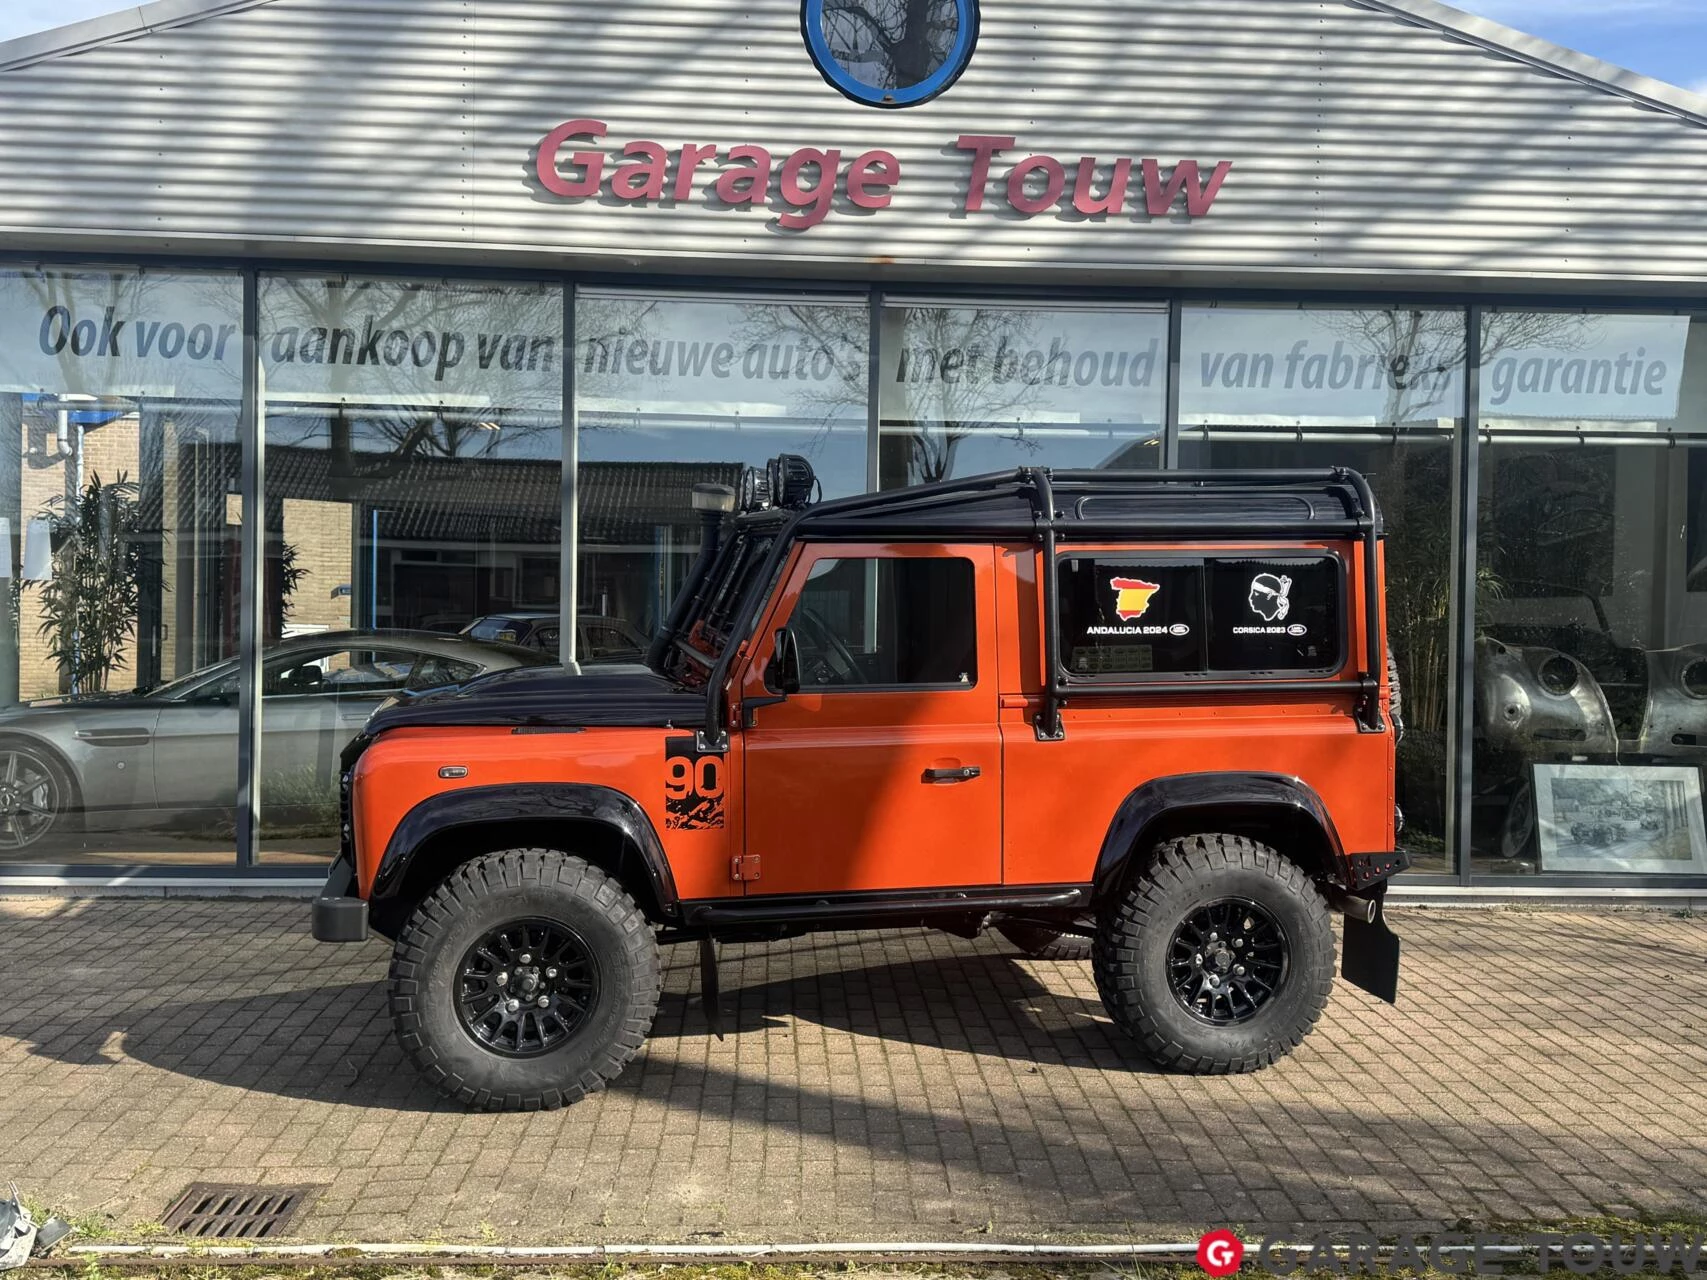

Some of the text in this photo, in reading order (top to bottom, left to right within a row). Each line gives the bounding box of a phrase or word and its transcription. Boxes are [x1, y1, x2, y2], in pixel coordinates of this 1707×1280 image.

[536, 119, 1233, 230] Garage Touw
[39, 306, 125, 358] Ook
[135, 322, 236, 361] voor
[272, 315, 465, 381] aankoop
[477, 332, 553, 373] van
[583, 327, 732, 378] nieuwe
[896, 340, 982, 384] met
[997, 337, 1160, 388] behoud
[1200, 351, 1274, 388] van
[1490, 347, 1667, 405] garantie
[1086, 626, 1142, 635] ANDALUCIA
[1143, 626, 1168, 635] 2024
[1232, 626, 1266, 634] CORSICA
[665, 755, 724, 800] 90
